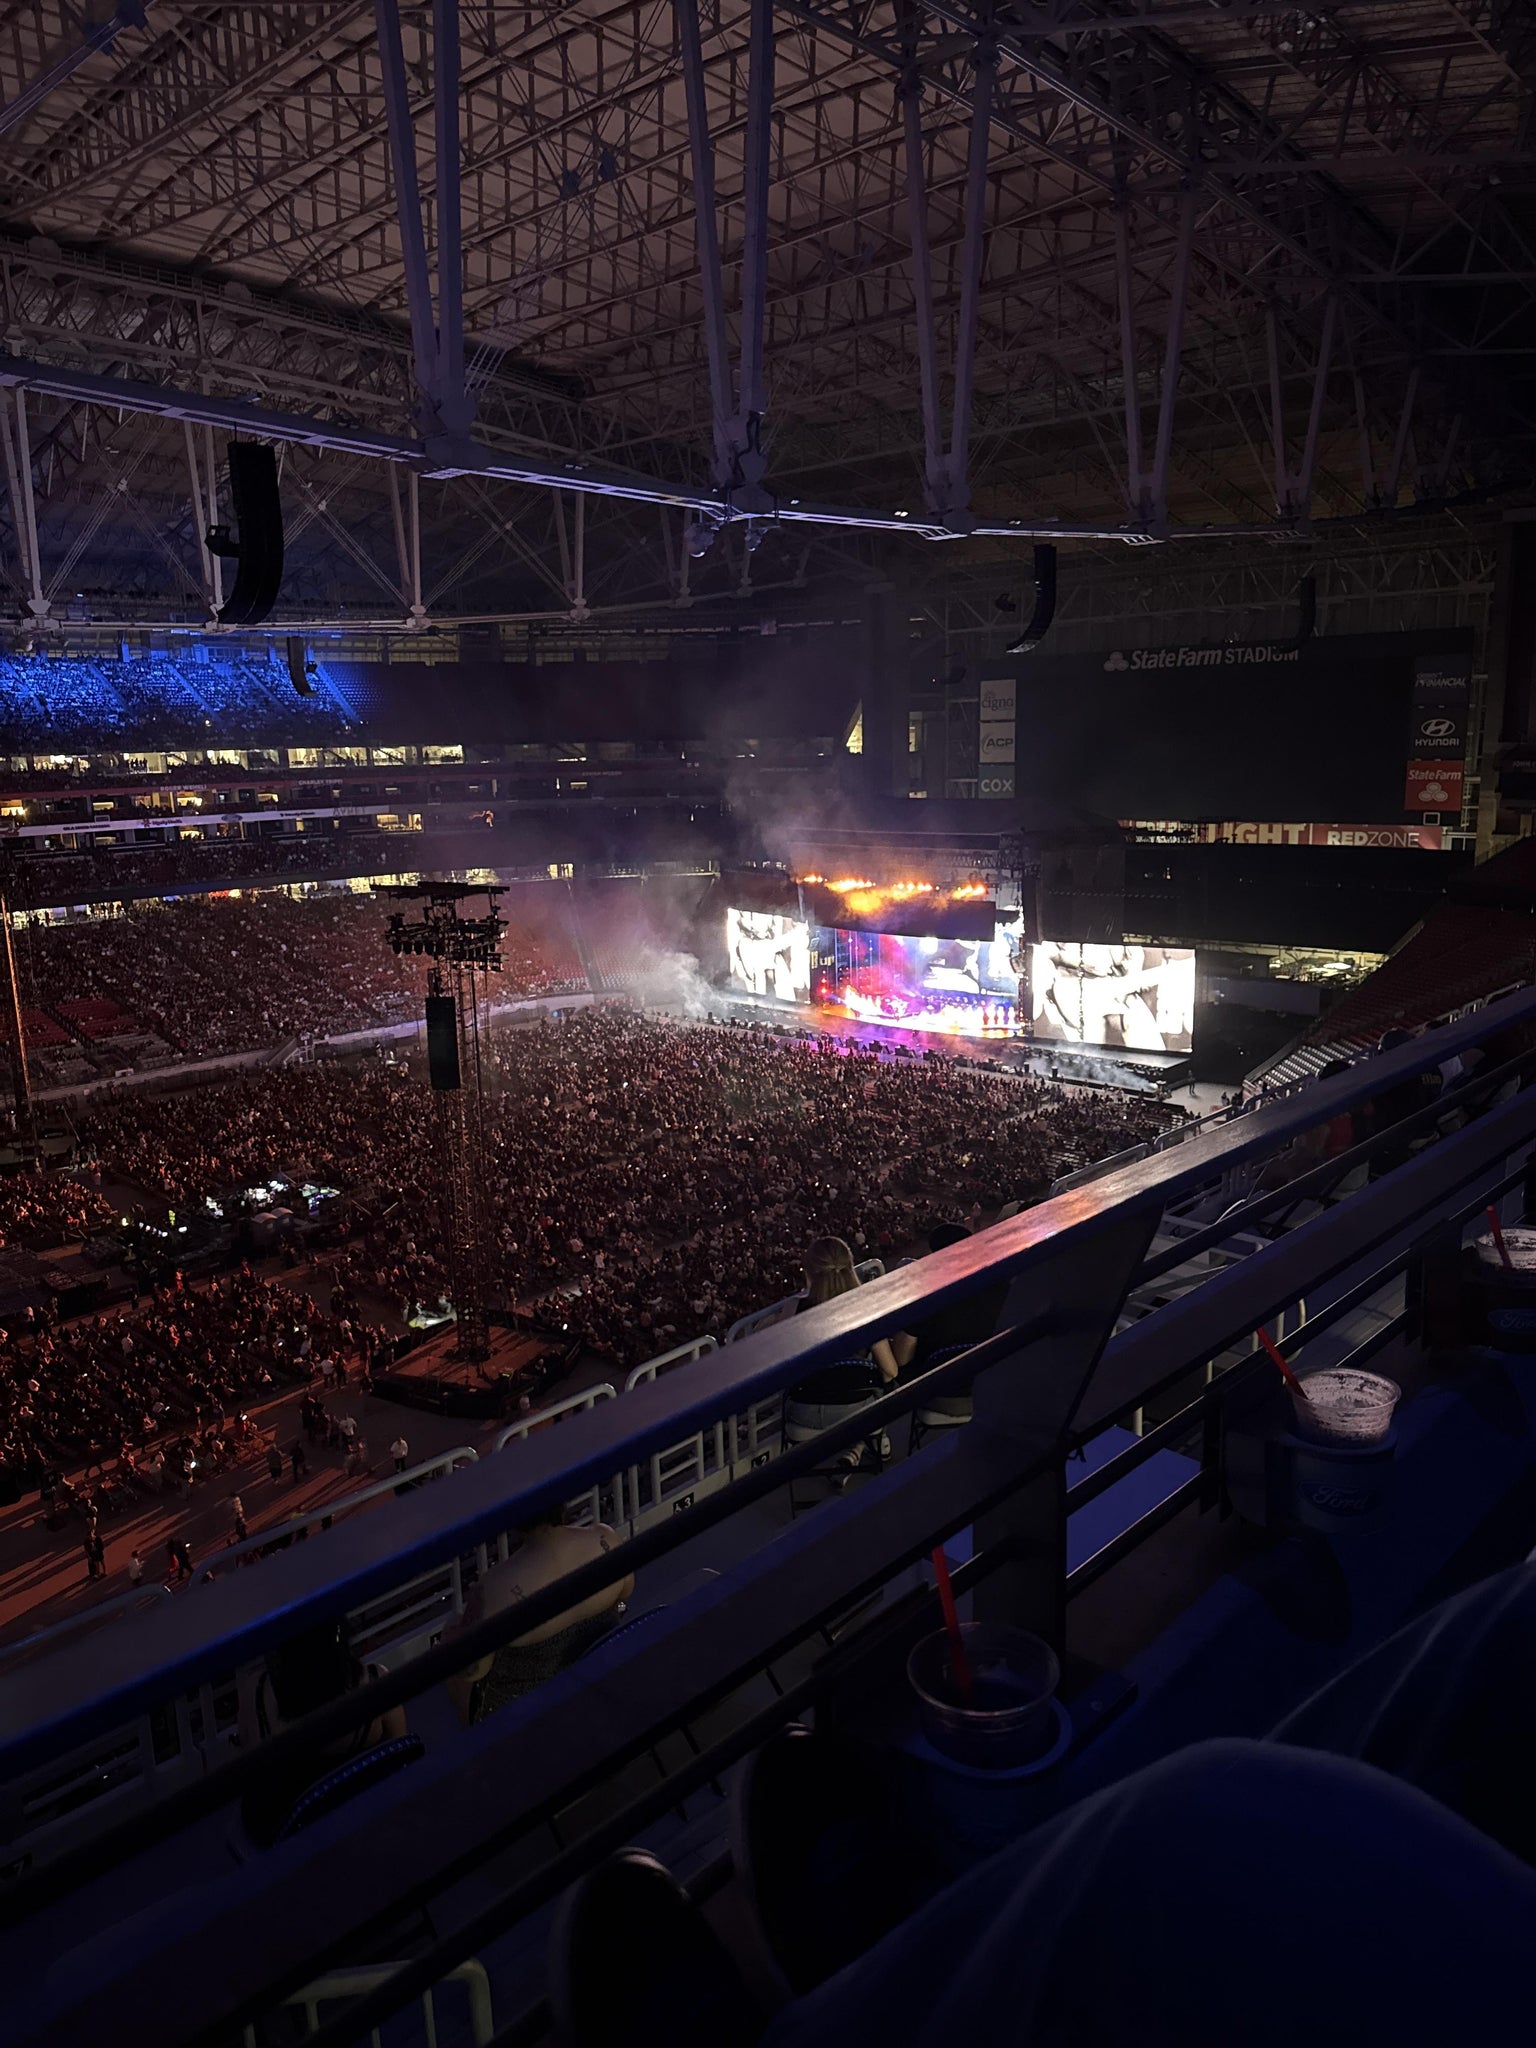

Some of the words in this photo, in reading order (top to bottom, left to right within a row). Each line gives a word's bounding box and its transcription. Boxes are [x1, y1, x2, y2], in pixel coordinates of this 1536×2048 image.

[1225, 646, 1298, 664] STADIUM
[986, 738, 1014, 748] ACP
[1415, 738, 1459, 747] HYUNDAI
[981, 779, 1013, 792] COX
[1327, 831, 1420, 848] REDZONE
[1313, 1486, 1368, 1509] Ford
